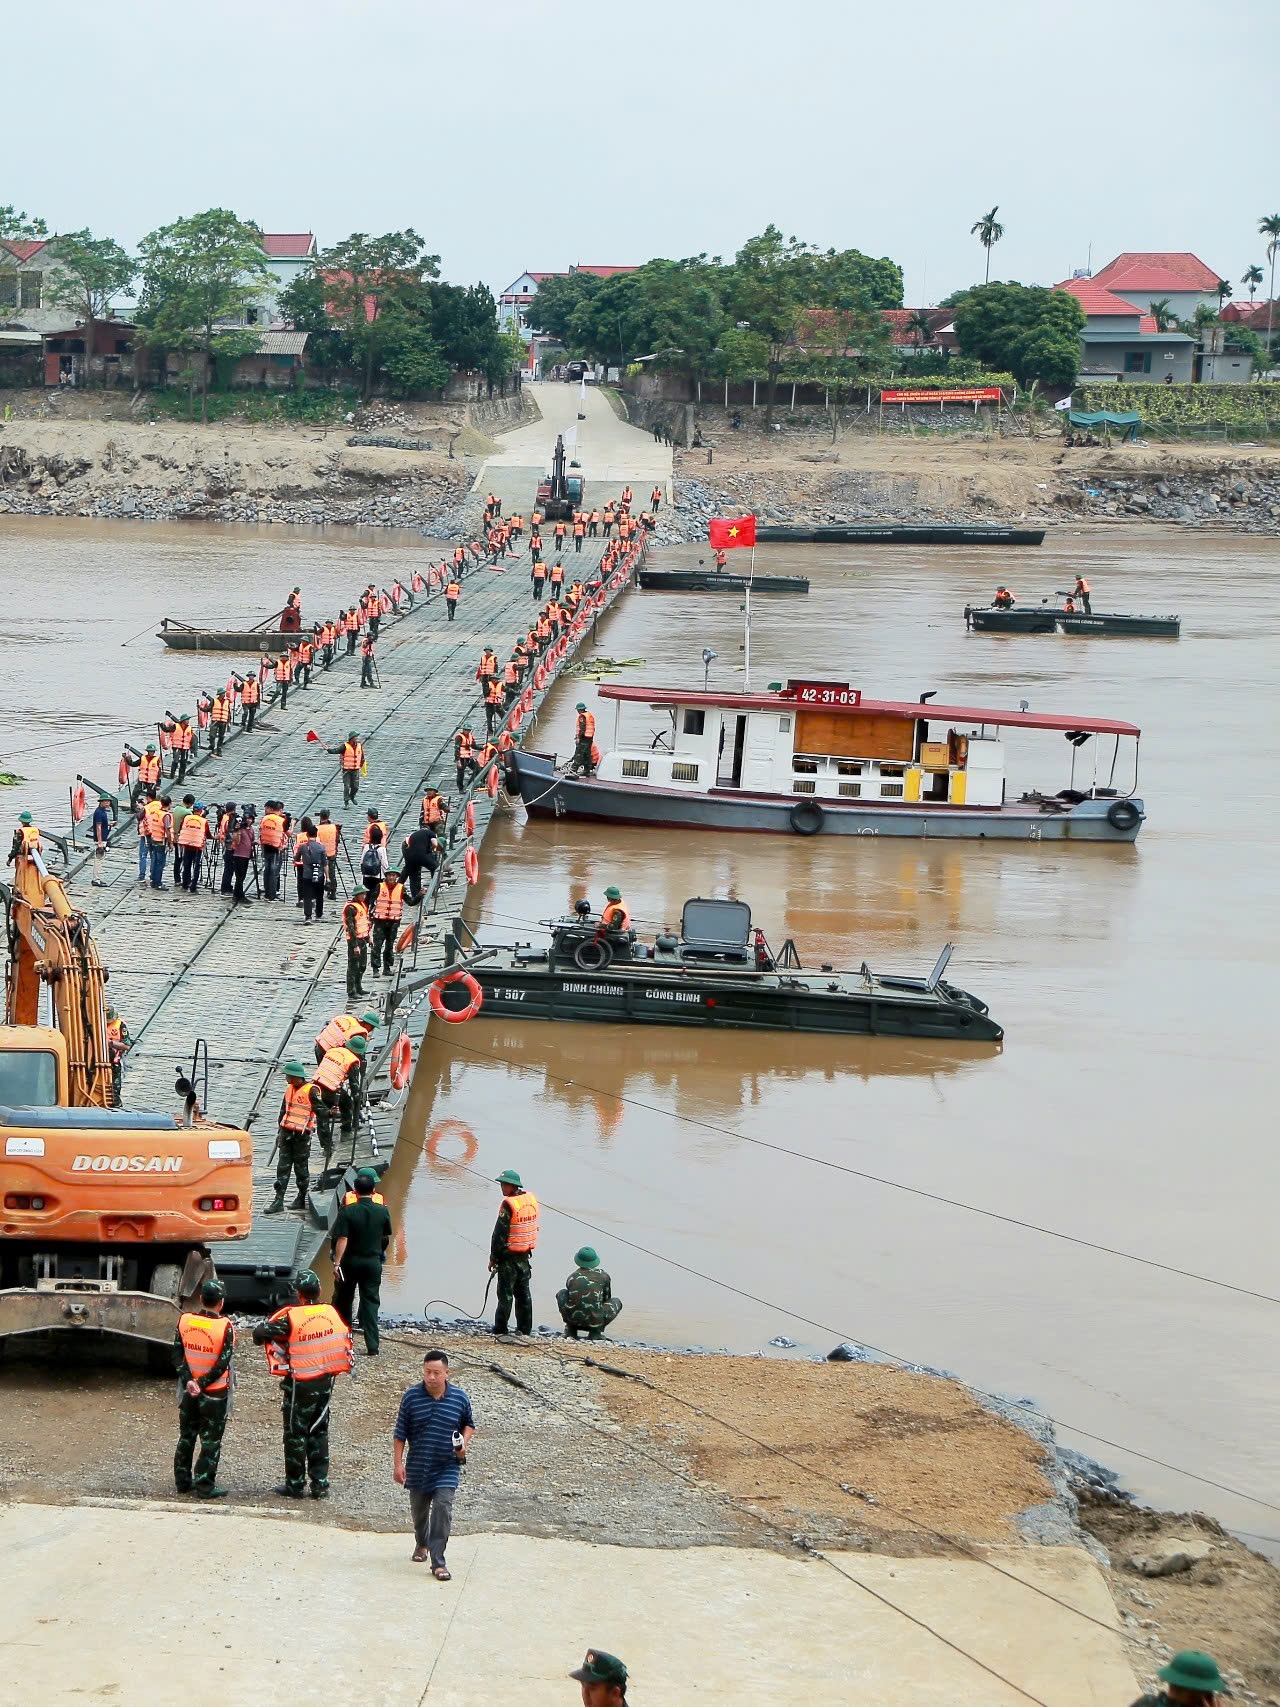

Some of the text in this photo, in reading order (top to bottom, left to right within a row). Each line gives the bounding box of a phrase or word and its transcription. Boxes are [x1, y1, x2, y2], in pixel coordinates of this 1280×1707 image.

[801, 688, 857, 705] 42-31-03
[562, 982, 587, 993] BINH
[675, 992, 701, 1003] BINH
[71, 1154, 184, 1172] DOOSAN
